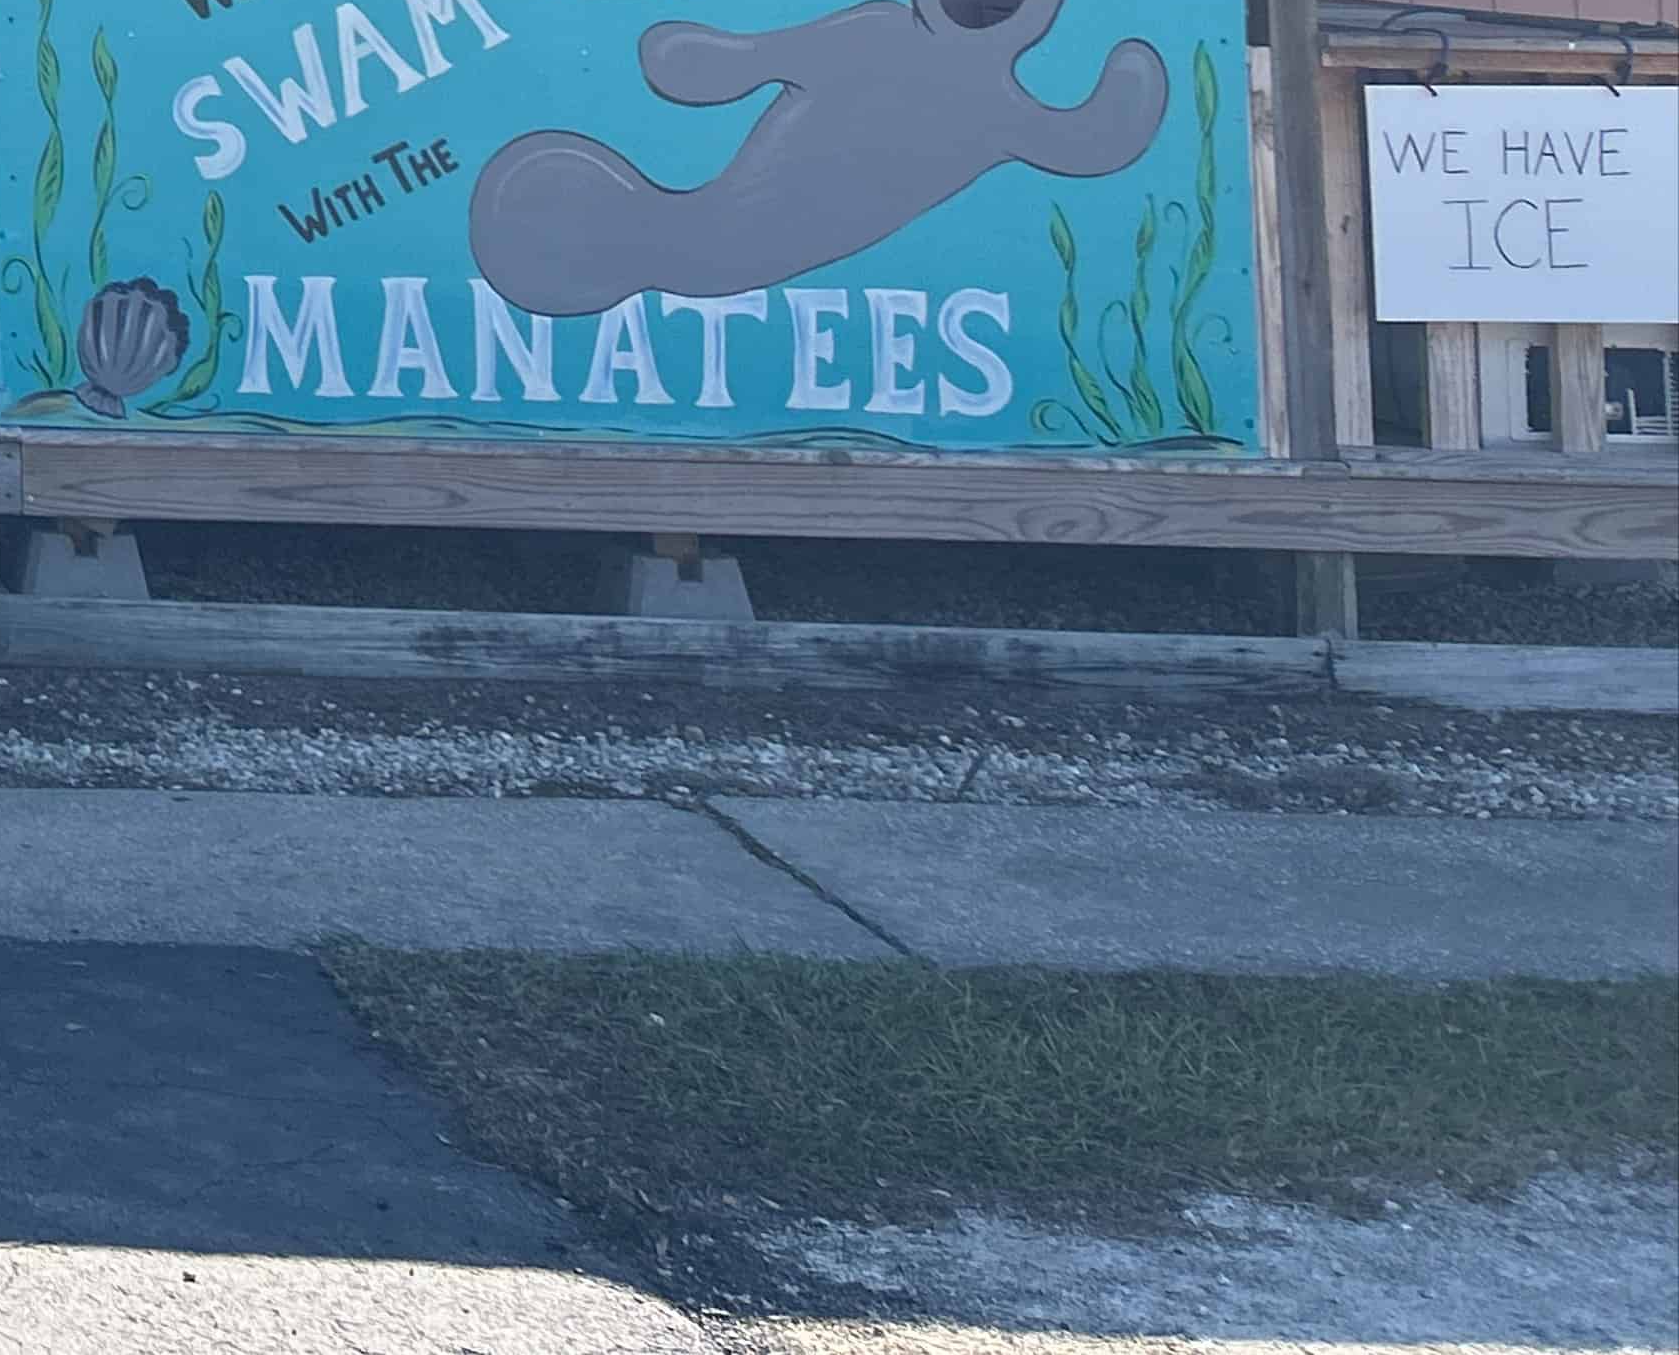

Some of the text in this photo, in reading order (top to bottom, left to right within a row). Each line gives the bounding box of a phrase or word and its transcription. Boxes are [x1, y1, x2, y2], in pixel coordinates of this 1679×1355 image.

[277, 137, 460, 245] WITH THE
[1384, 128, 1632, 177] WE HAVE
[1443, 198, 1590, 272] ICE
[235, 274, 1014, 417] MANATEES
